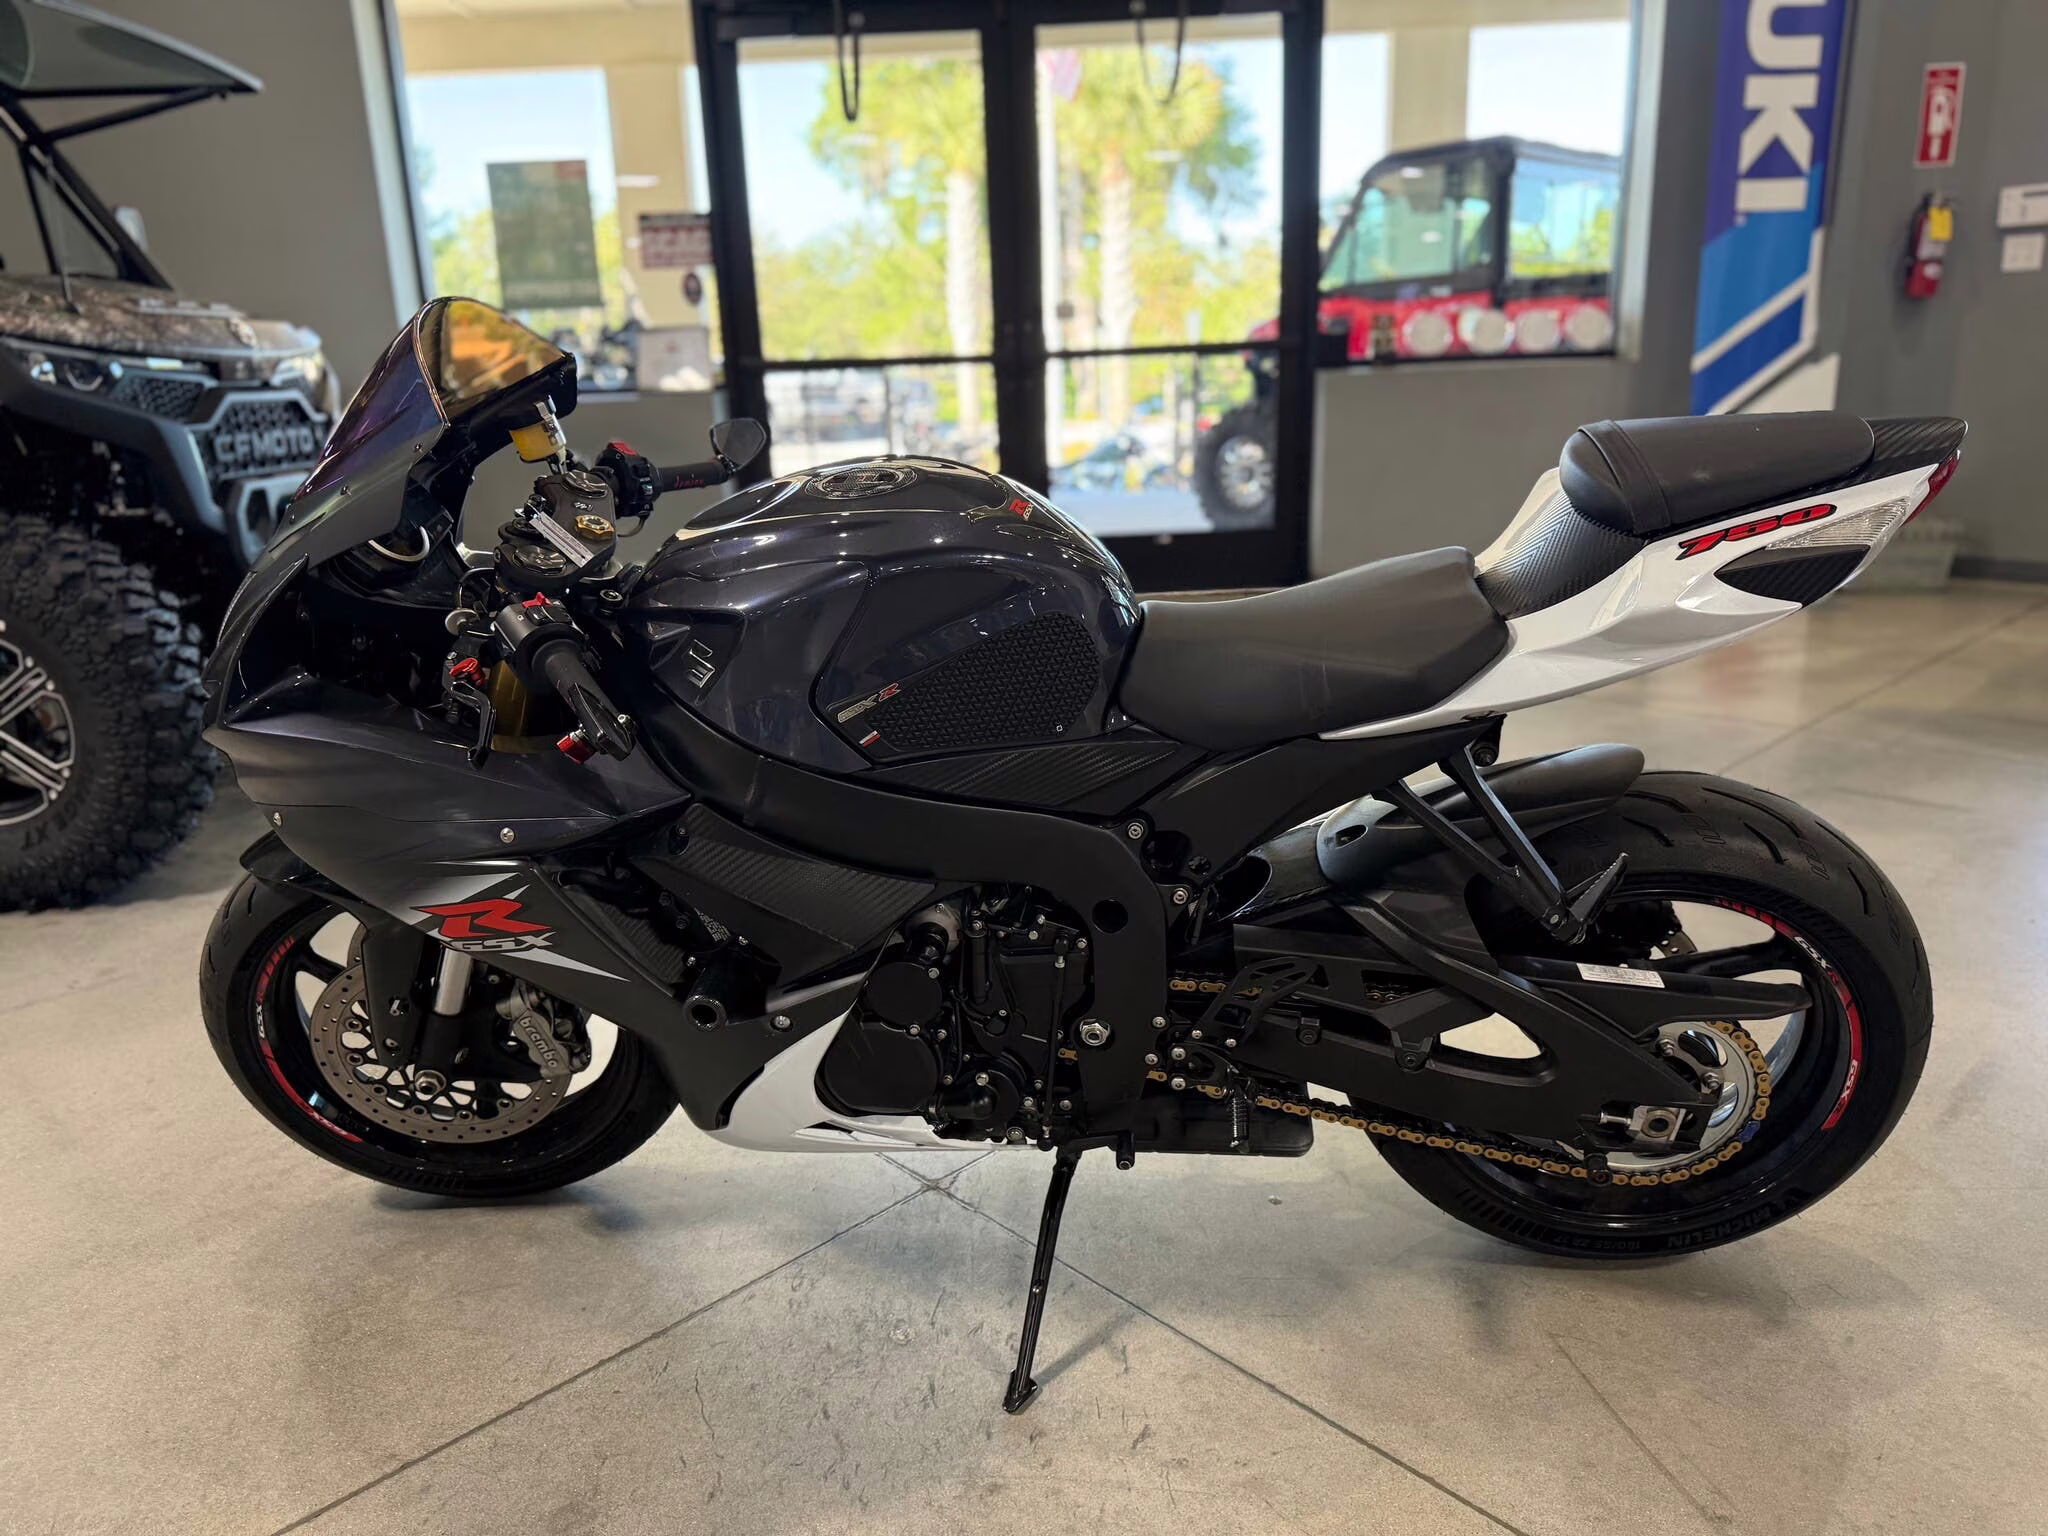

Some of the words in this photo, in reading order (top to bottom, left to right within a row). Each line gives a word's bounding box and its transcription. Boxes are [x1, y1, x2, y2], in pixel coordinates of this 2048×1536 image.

[213, 426, 314, 462] CFMOTO
[1675, 503, 1838, 561] 750
[408, 897, 552, 939] R
[450, 931, 557, 951] GSX
[519, 1016, 559, 1069] brembo
